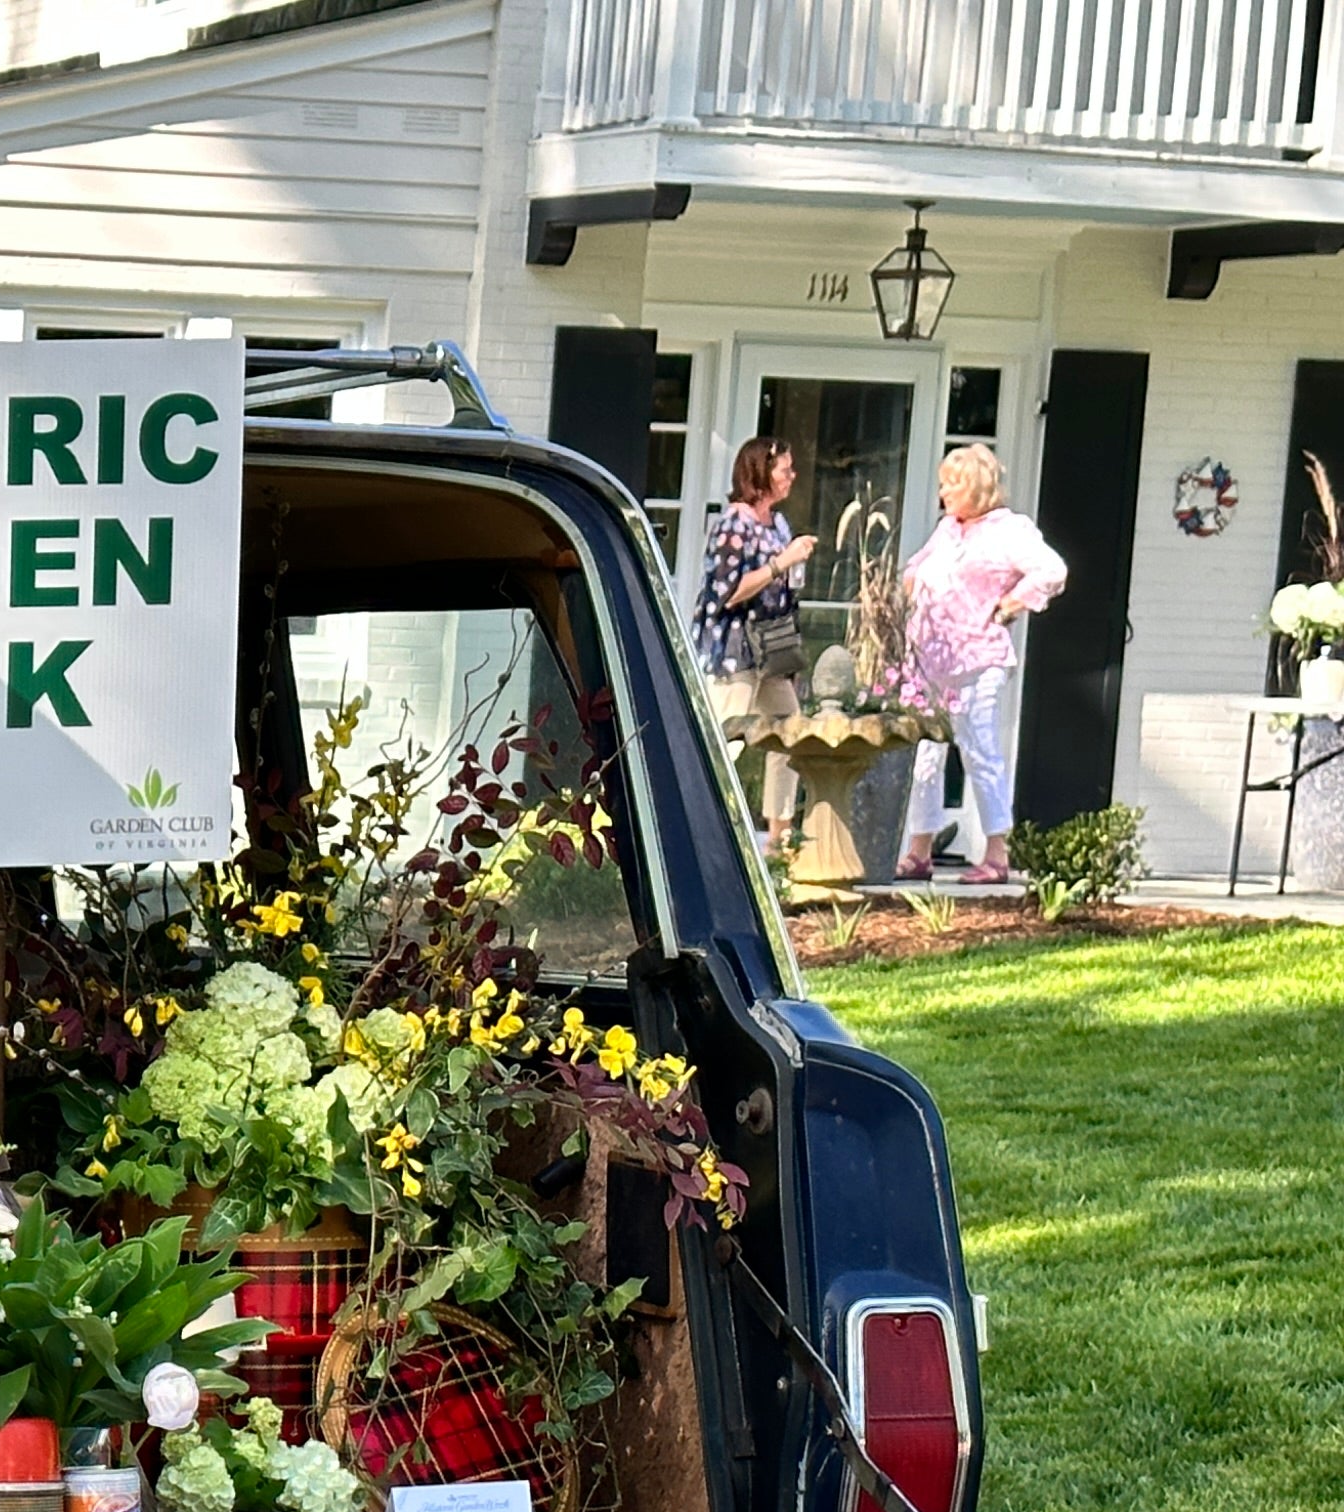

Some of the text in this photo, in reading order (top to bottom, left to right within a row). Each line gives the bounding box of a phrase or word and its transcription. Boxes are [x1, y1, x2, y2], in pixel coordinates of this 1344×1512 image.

[806, 272, 849, 303] 1114
[90, 816, 215, 834] GARDEN CLUB
[95, 838, 208, 850] OF VIRGINIA
